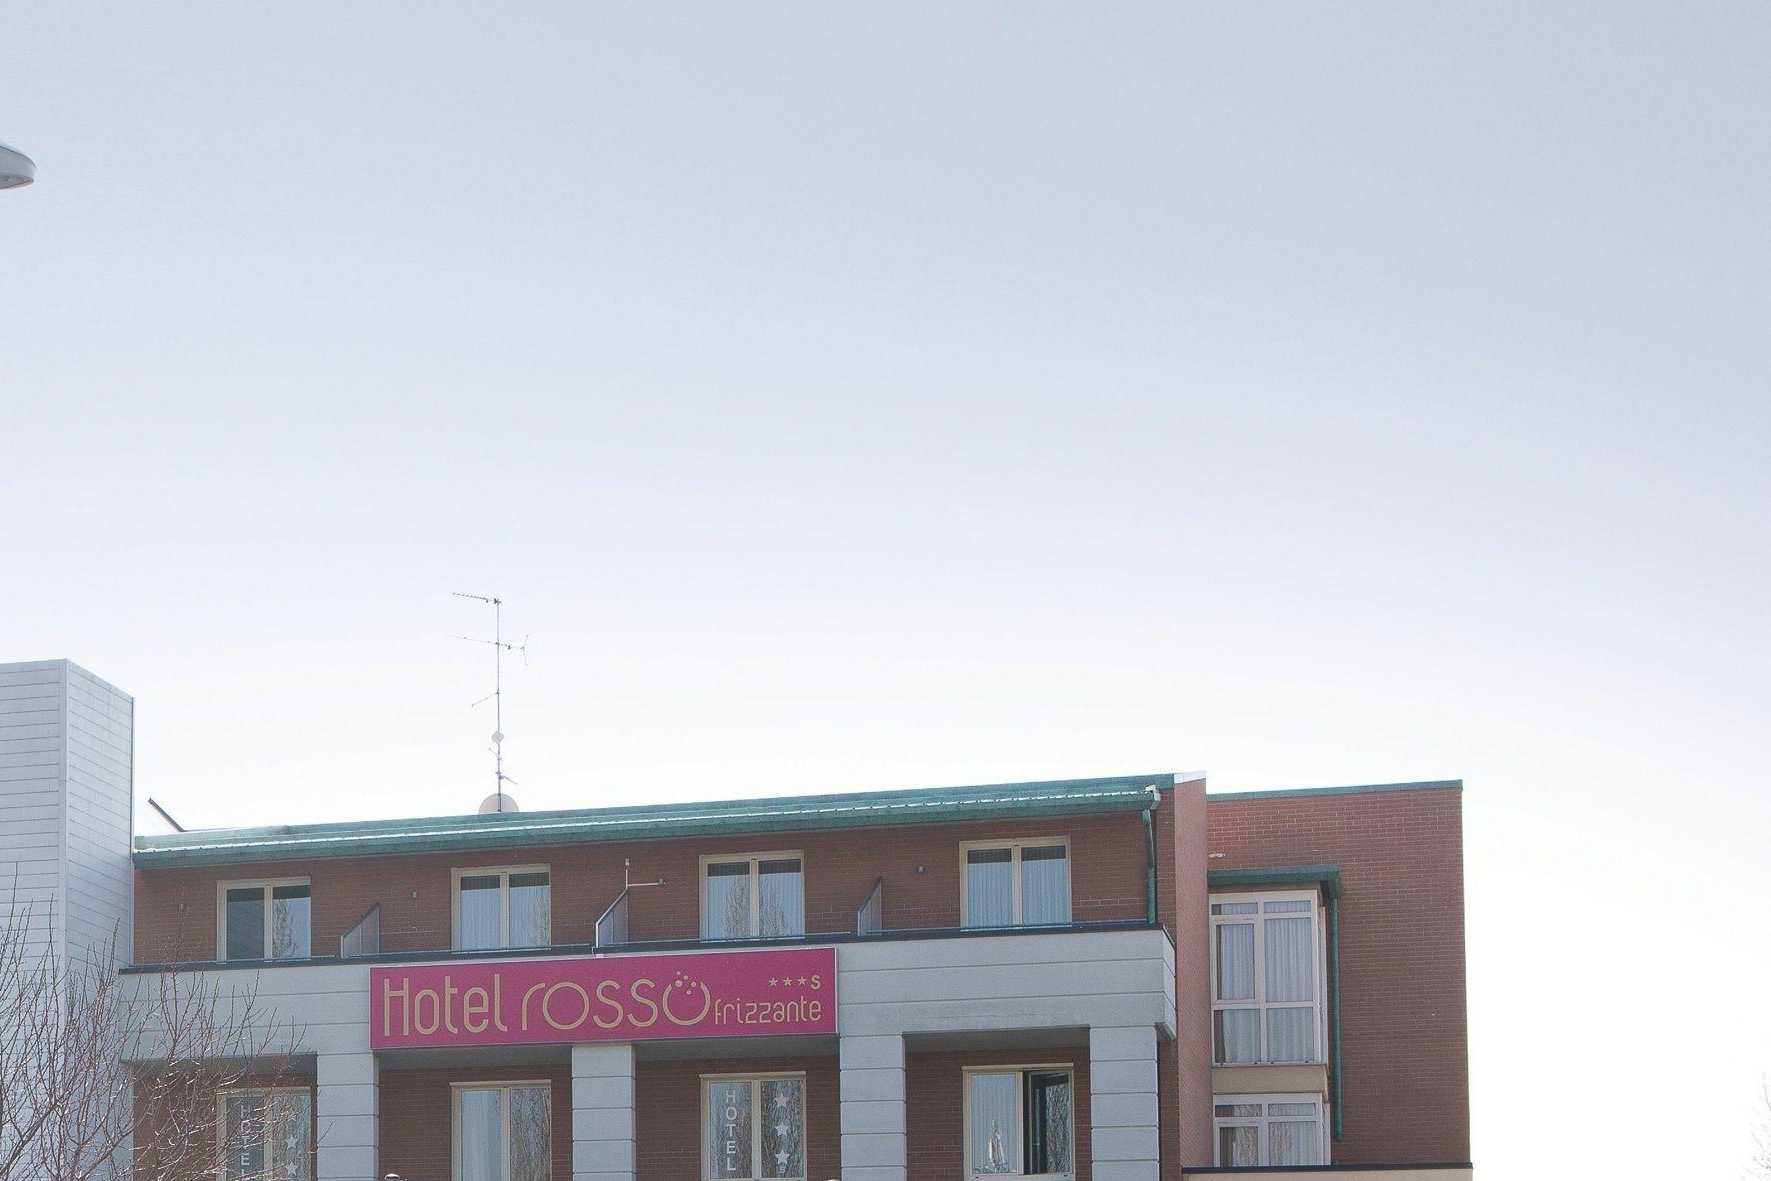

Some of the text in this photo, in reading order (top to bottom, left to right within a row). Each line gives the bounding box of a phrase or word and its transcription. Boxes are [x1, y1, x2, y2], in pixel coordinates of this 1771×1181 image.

[383, 973, 507, 1037] Hotel
[714, 995, 822, 1025] frizzante
[725, 1090, 738, 1171] HOTEL
